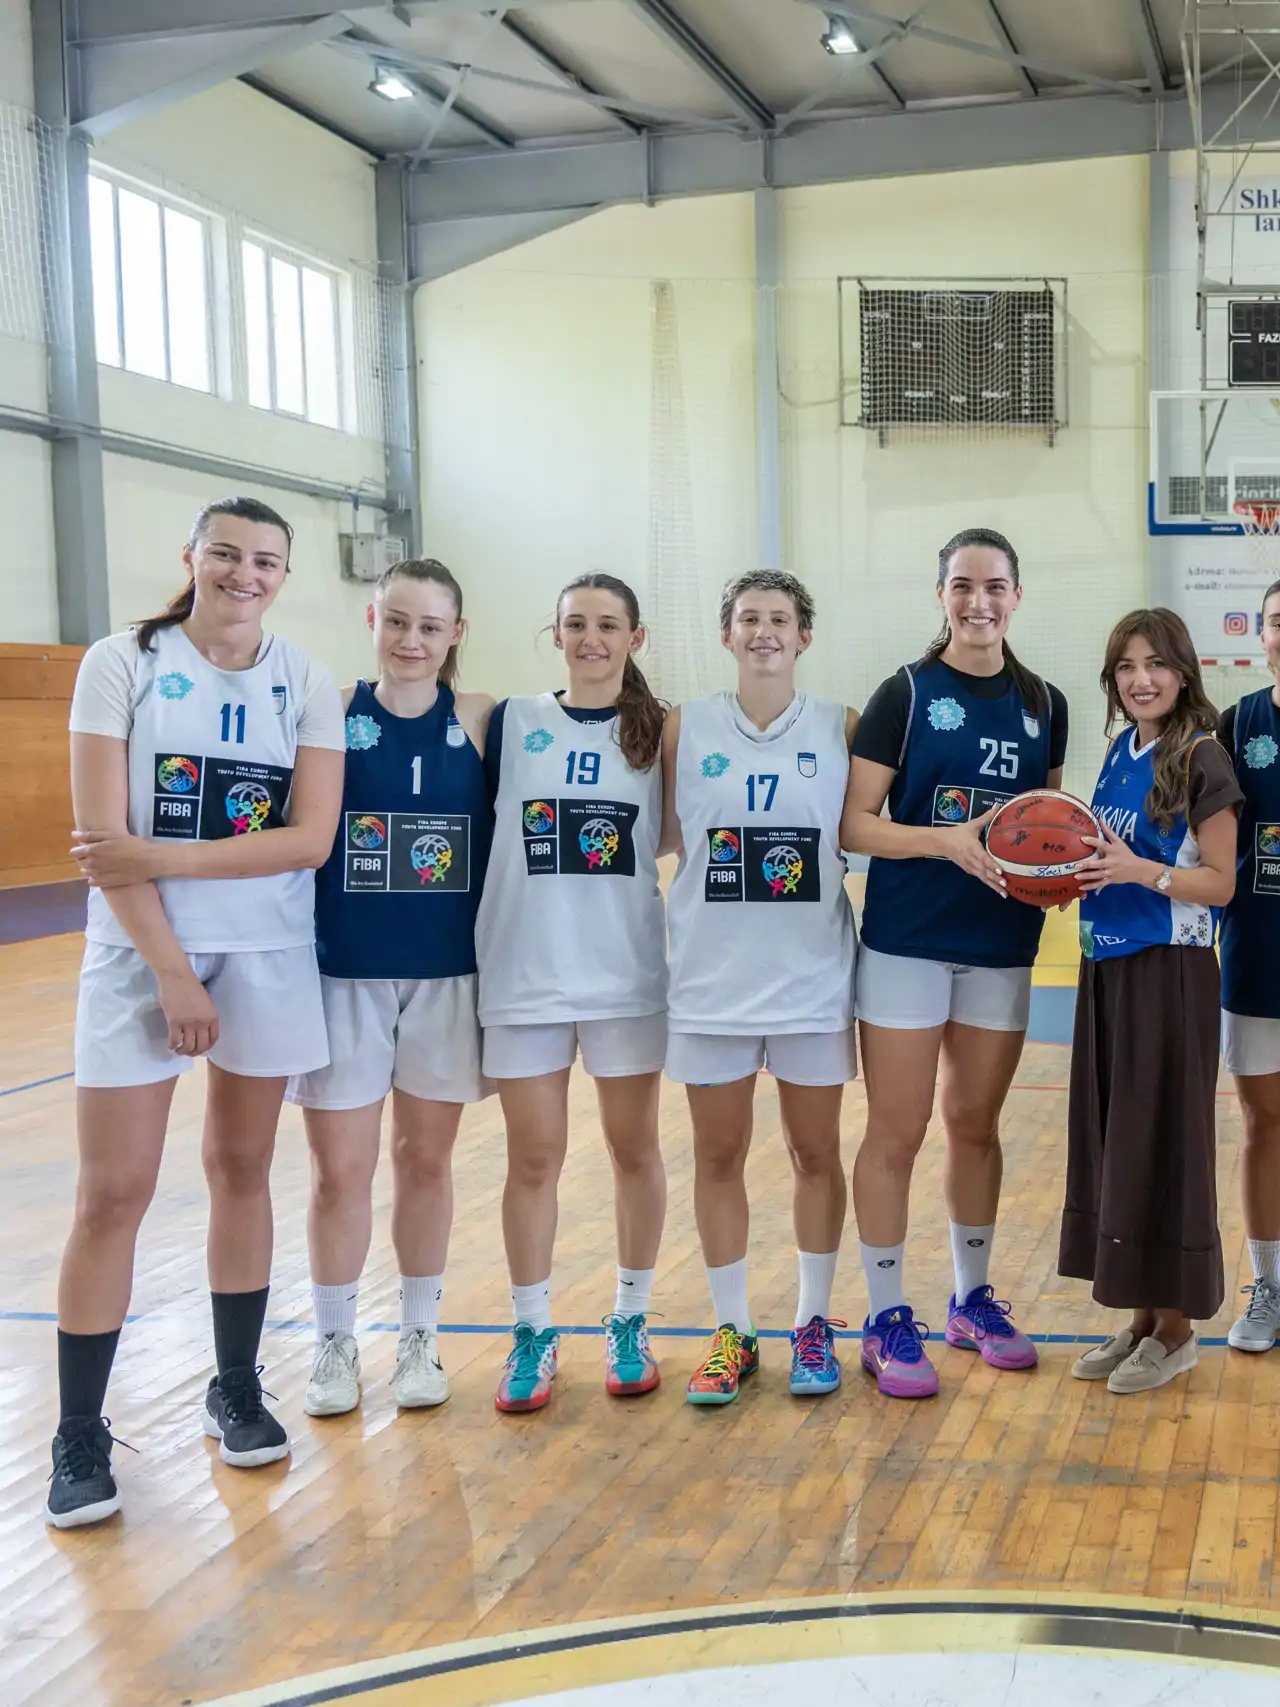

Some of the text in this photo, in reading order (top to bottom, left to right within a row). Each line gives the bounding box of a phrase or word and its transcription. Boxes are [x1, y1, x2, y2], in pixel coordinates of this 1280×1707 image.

[220, 703, 246, 744] 11
[979, 737, 1019, 779] 25
[236, 765, 250, 773] FIBA
[565, 750, 601, 785] 19
[236, 770, 270, 780] DEVELOPMENT
[411, 755, 422, 795] 1
[745, 774, 780, 812] 17
[160, 802, 192, 817] FIBA
[530, 842, 551, 856] FIBA
[353, 858, 381, 871] FIBA
[710, 870, 736, 883] FIBA
[1015, 886, 1068, 897] molten
